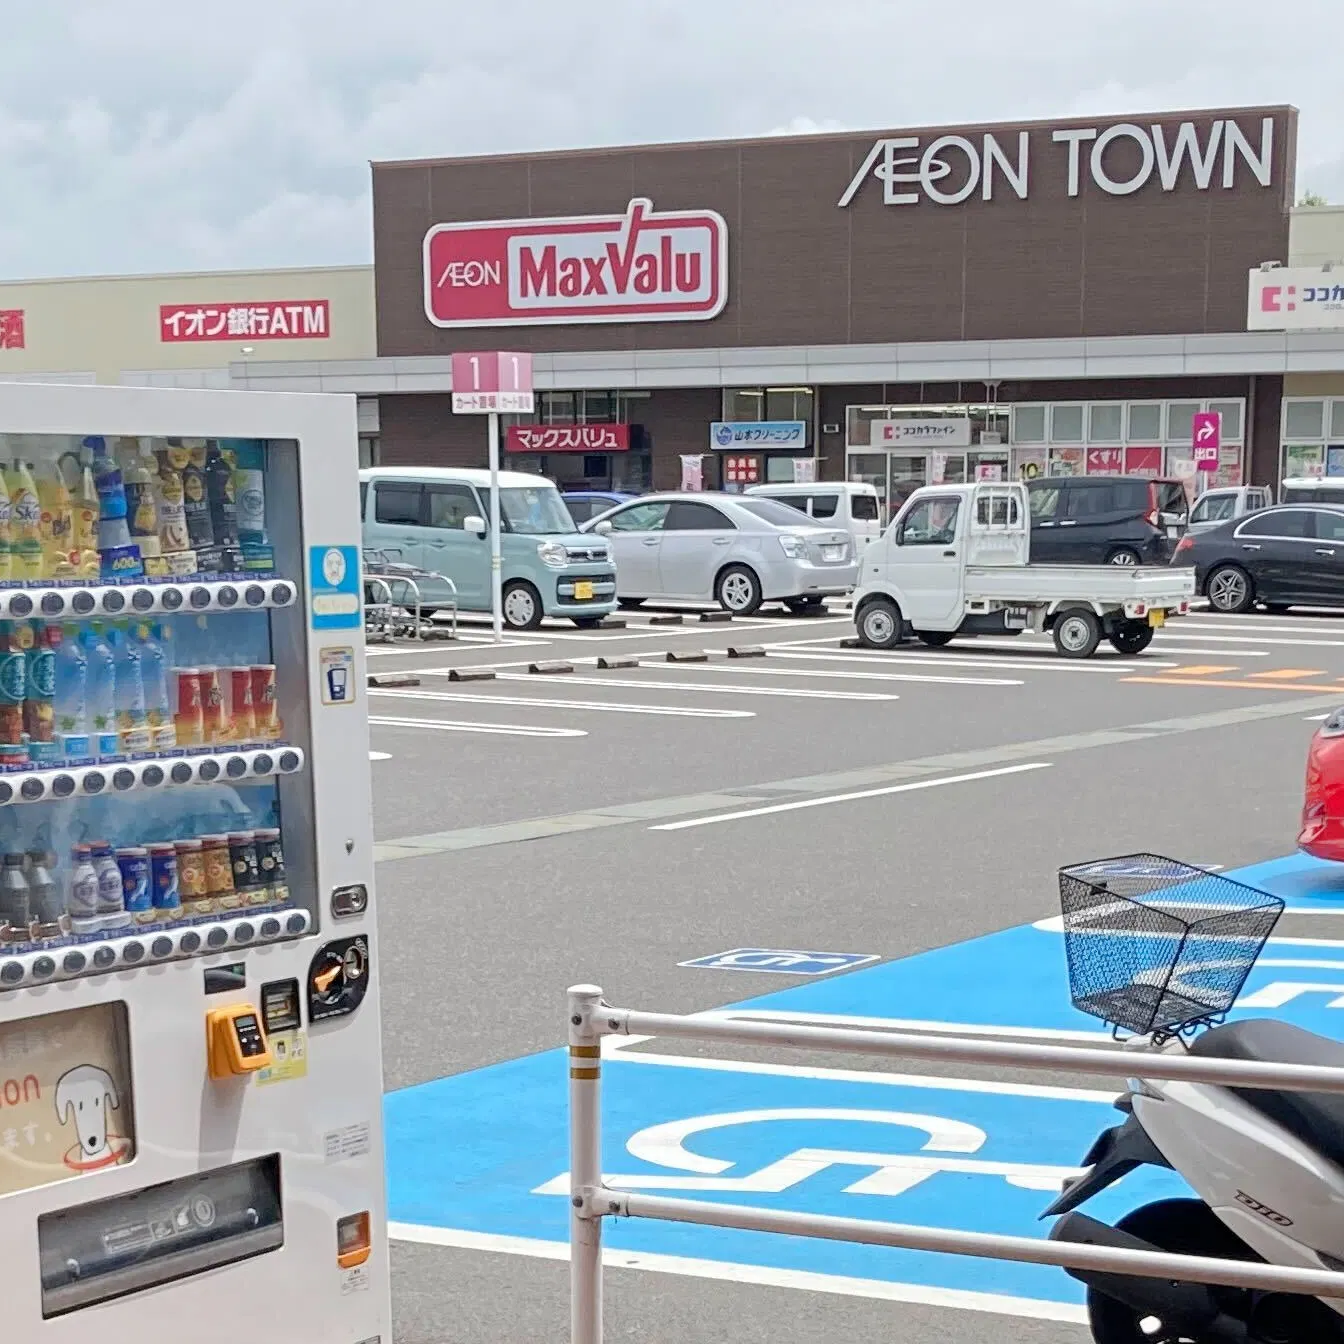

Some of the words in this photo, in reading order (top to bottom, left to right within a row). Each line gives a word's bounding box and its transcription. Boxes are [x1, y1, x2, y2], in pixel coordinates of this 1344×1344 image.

[1052, 116, 1275, 197] TOWN
[518, 204, 702, 299] MaxValu
[163, 304, 327, 336] イオン銀行ATM
[469, 356, 481, 390] 1
[511, 356, 520, 390] 1
[516, 428, 618, 449] マックスバリュ
[1193, 447, 1217, 460] 出口
